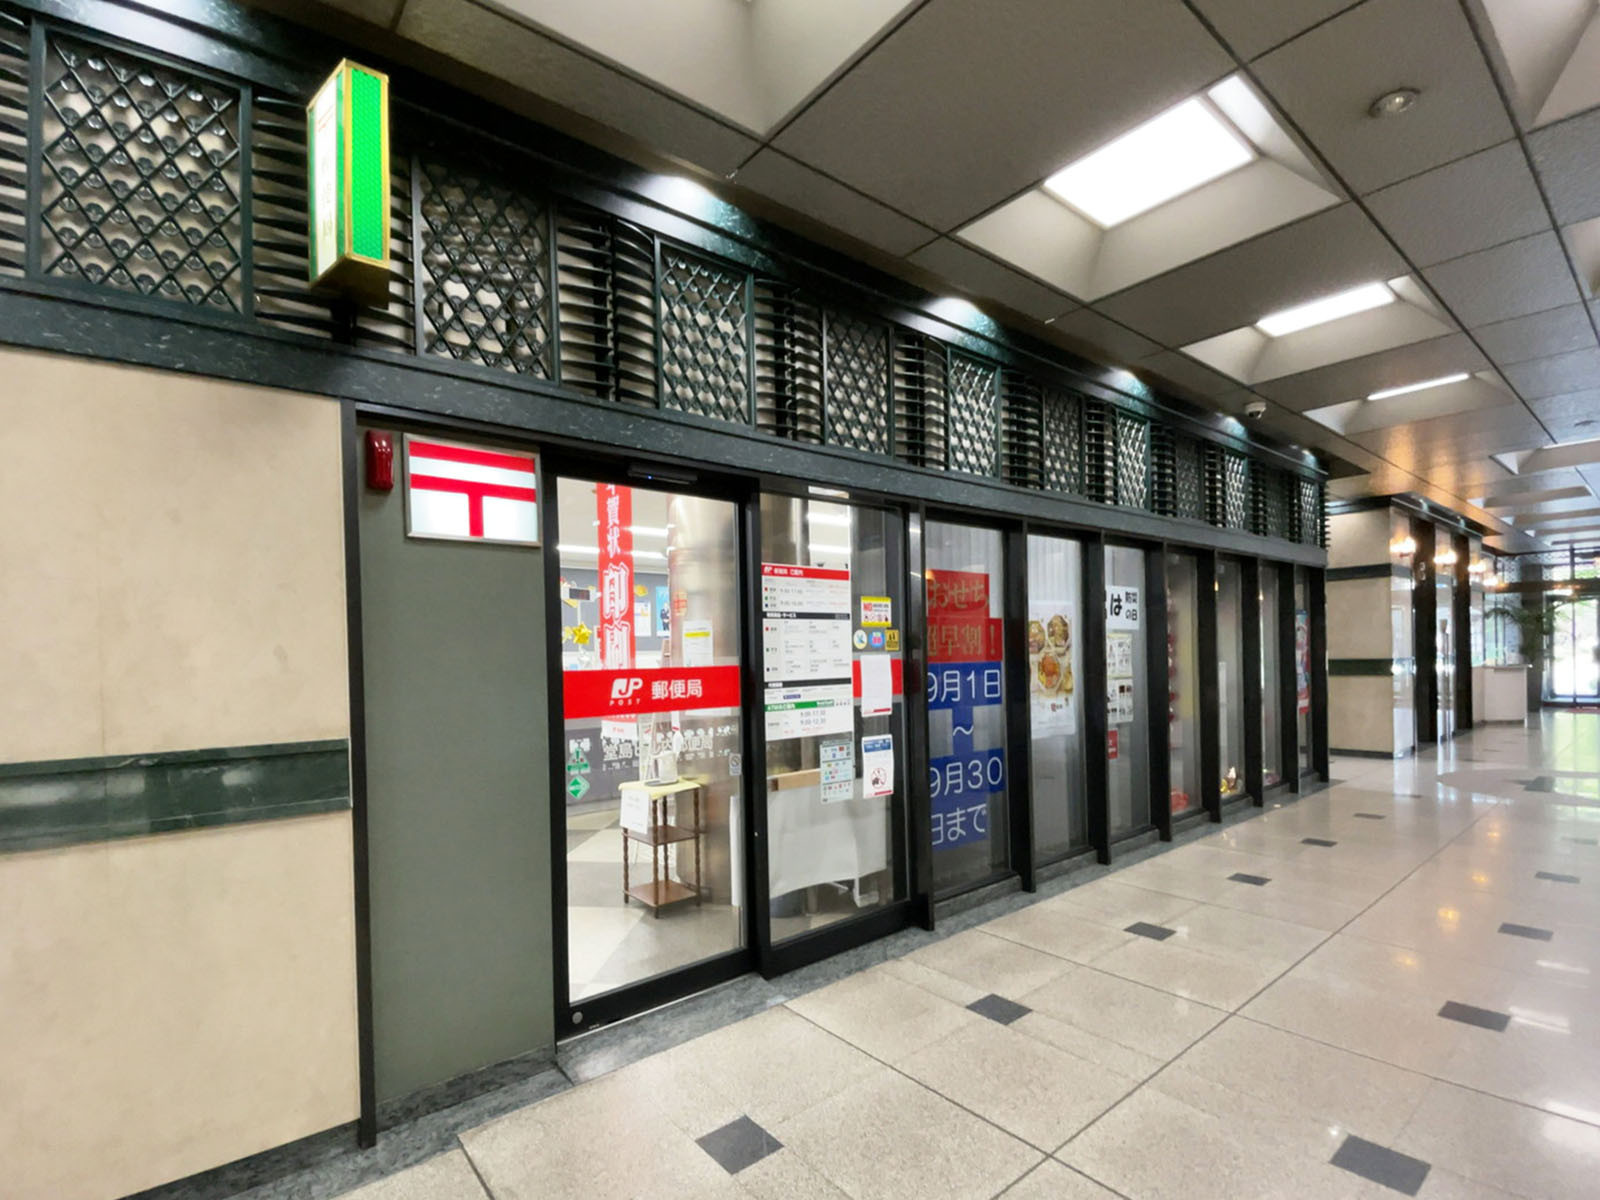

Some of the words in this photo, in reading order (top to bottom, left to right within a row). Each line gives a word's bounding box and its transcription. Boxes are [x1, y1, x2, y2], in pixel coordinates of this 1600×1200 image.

[609, 698, 641, 706] POST
[650, 679, 703, 700] 郵便局
[927, 669, 1001, 703] 9月1日
[929, 756, 1003, 798] 9月30
[931, 803, 987, 846] 日まで
